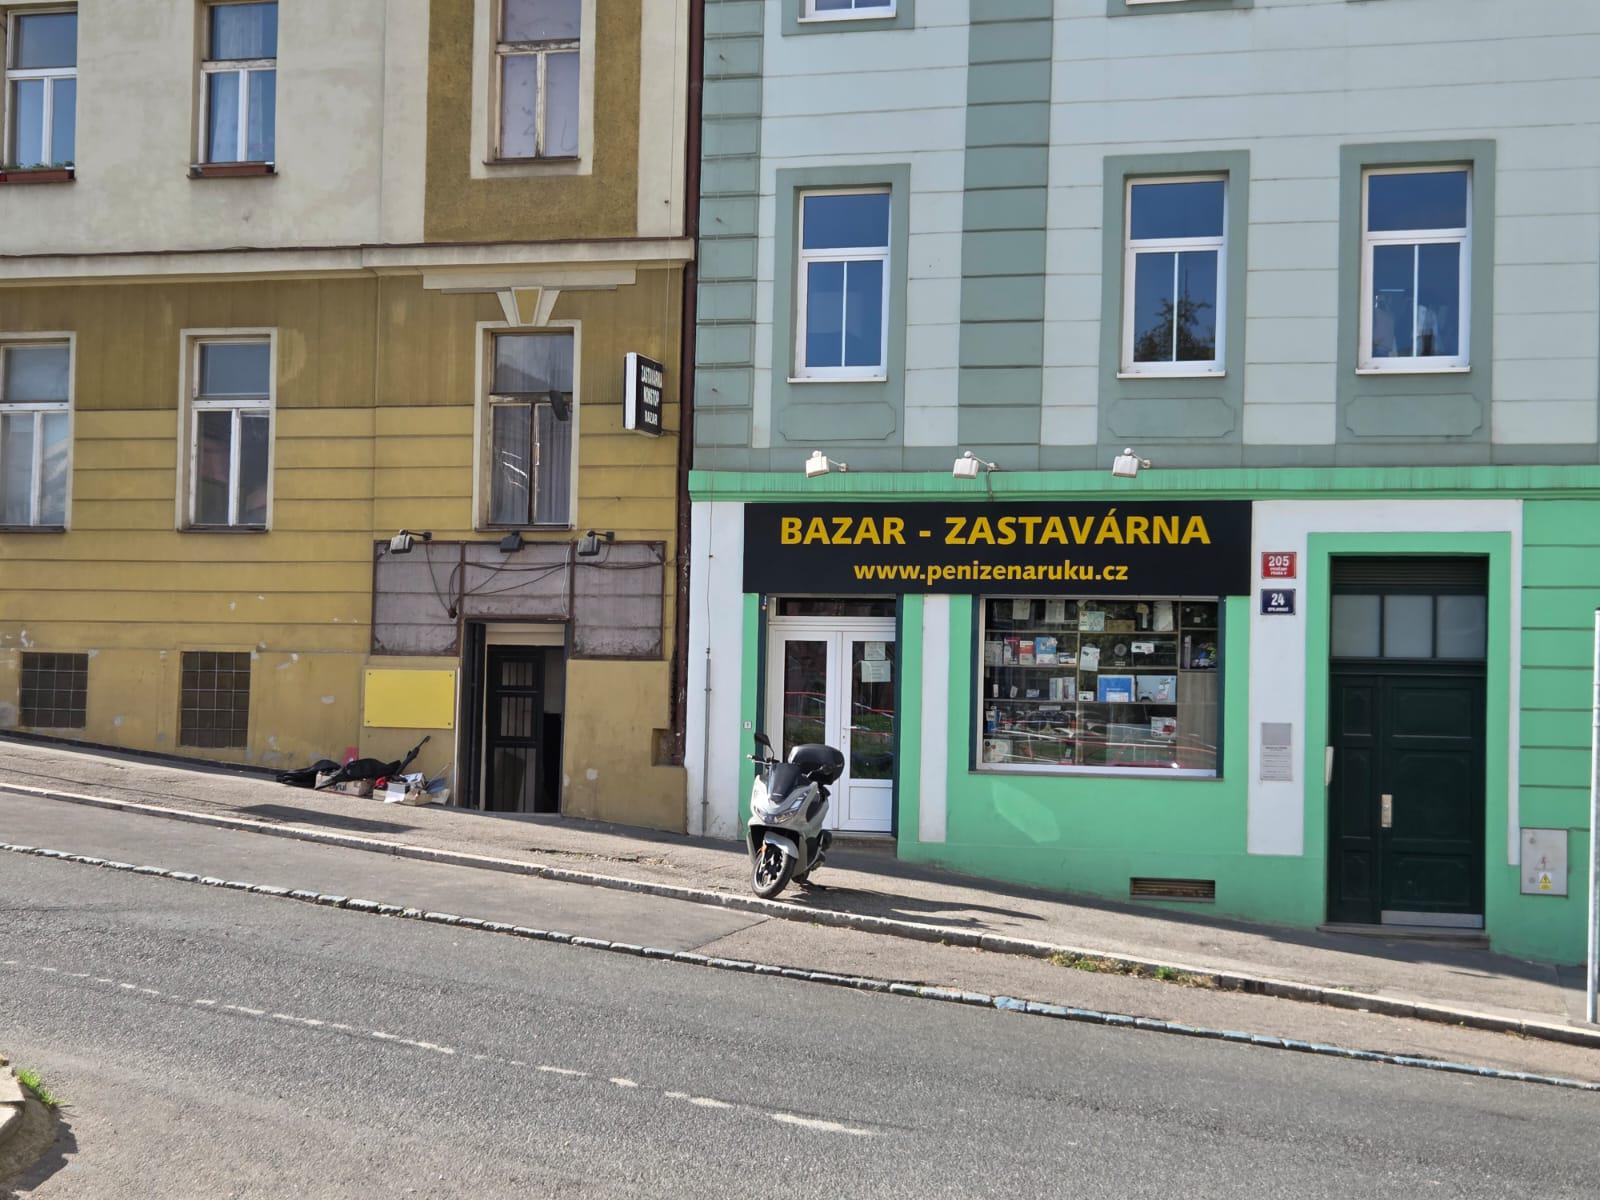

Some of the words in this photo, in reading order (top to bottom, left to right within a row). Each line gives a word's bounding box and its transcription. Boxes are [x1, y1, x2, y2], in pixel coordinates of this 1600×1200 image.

[780, 516, 906, 545] BAZAR
[944, 508, 1211, 545] ZASTAVÁRNA
[1268, 555, 1289, 567] 205
[854, 559, 1129, 586] www.penizenaruku.cz
[1271, 592, 1285, 606] 24
